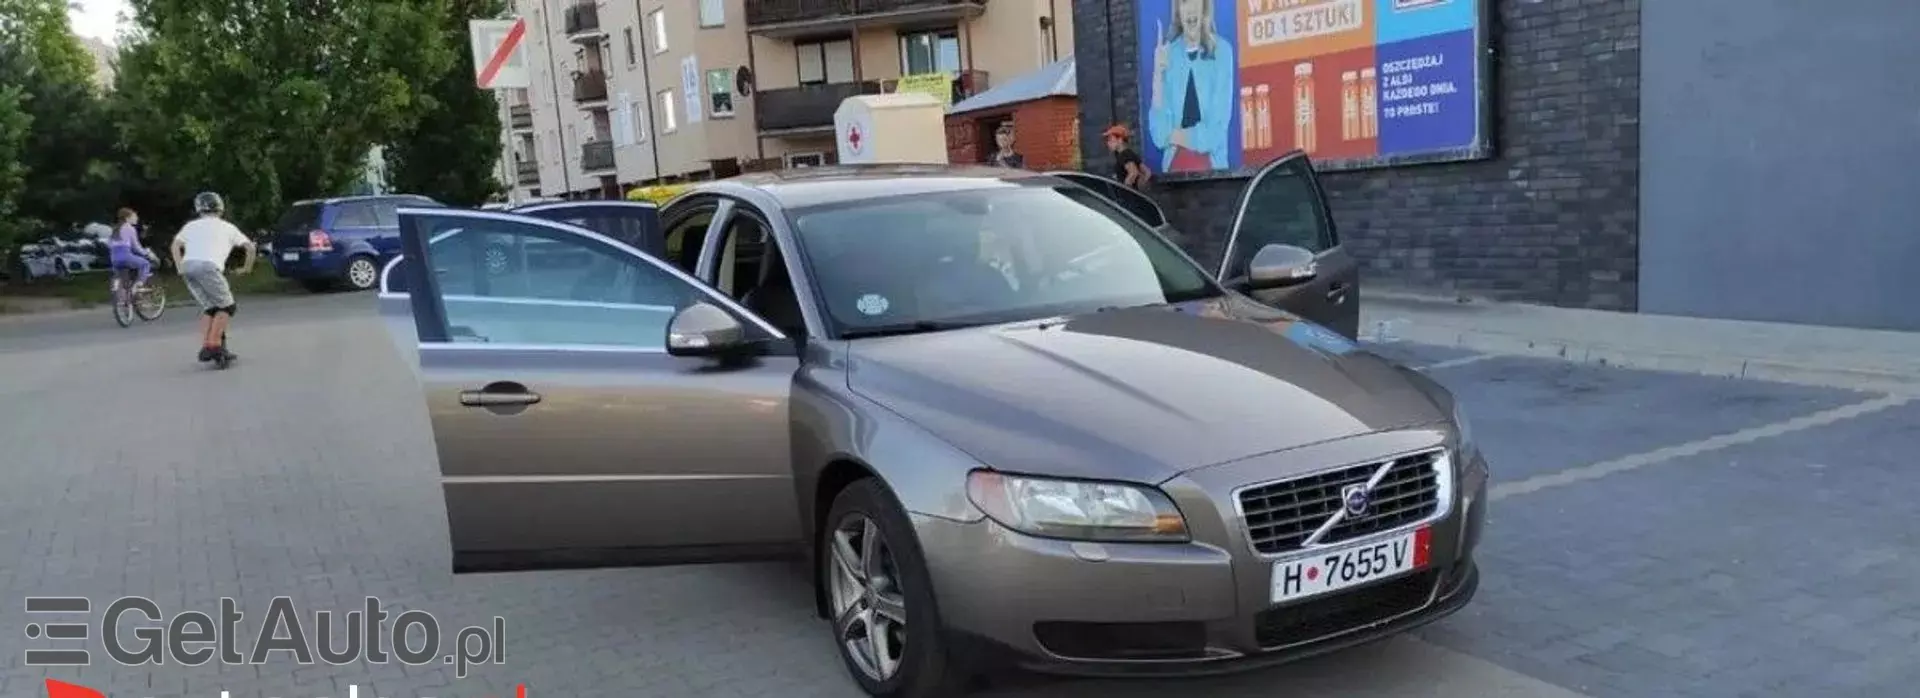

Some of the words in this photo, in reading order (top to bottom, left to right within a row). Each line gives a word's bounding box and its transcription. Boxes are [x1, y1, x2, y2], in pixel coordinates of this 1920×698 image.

[1253, 18, 1275, 39] OD
[1293, 3, 1356, 33] SZTUKI
[1283, 563, 1302, 595] H
[1325, 543, 1388, 586] 7655
[1392, 535, 1409, 568] V
